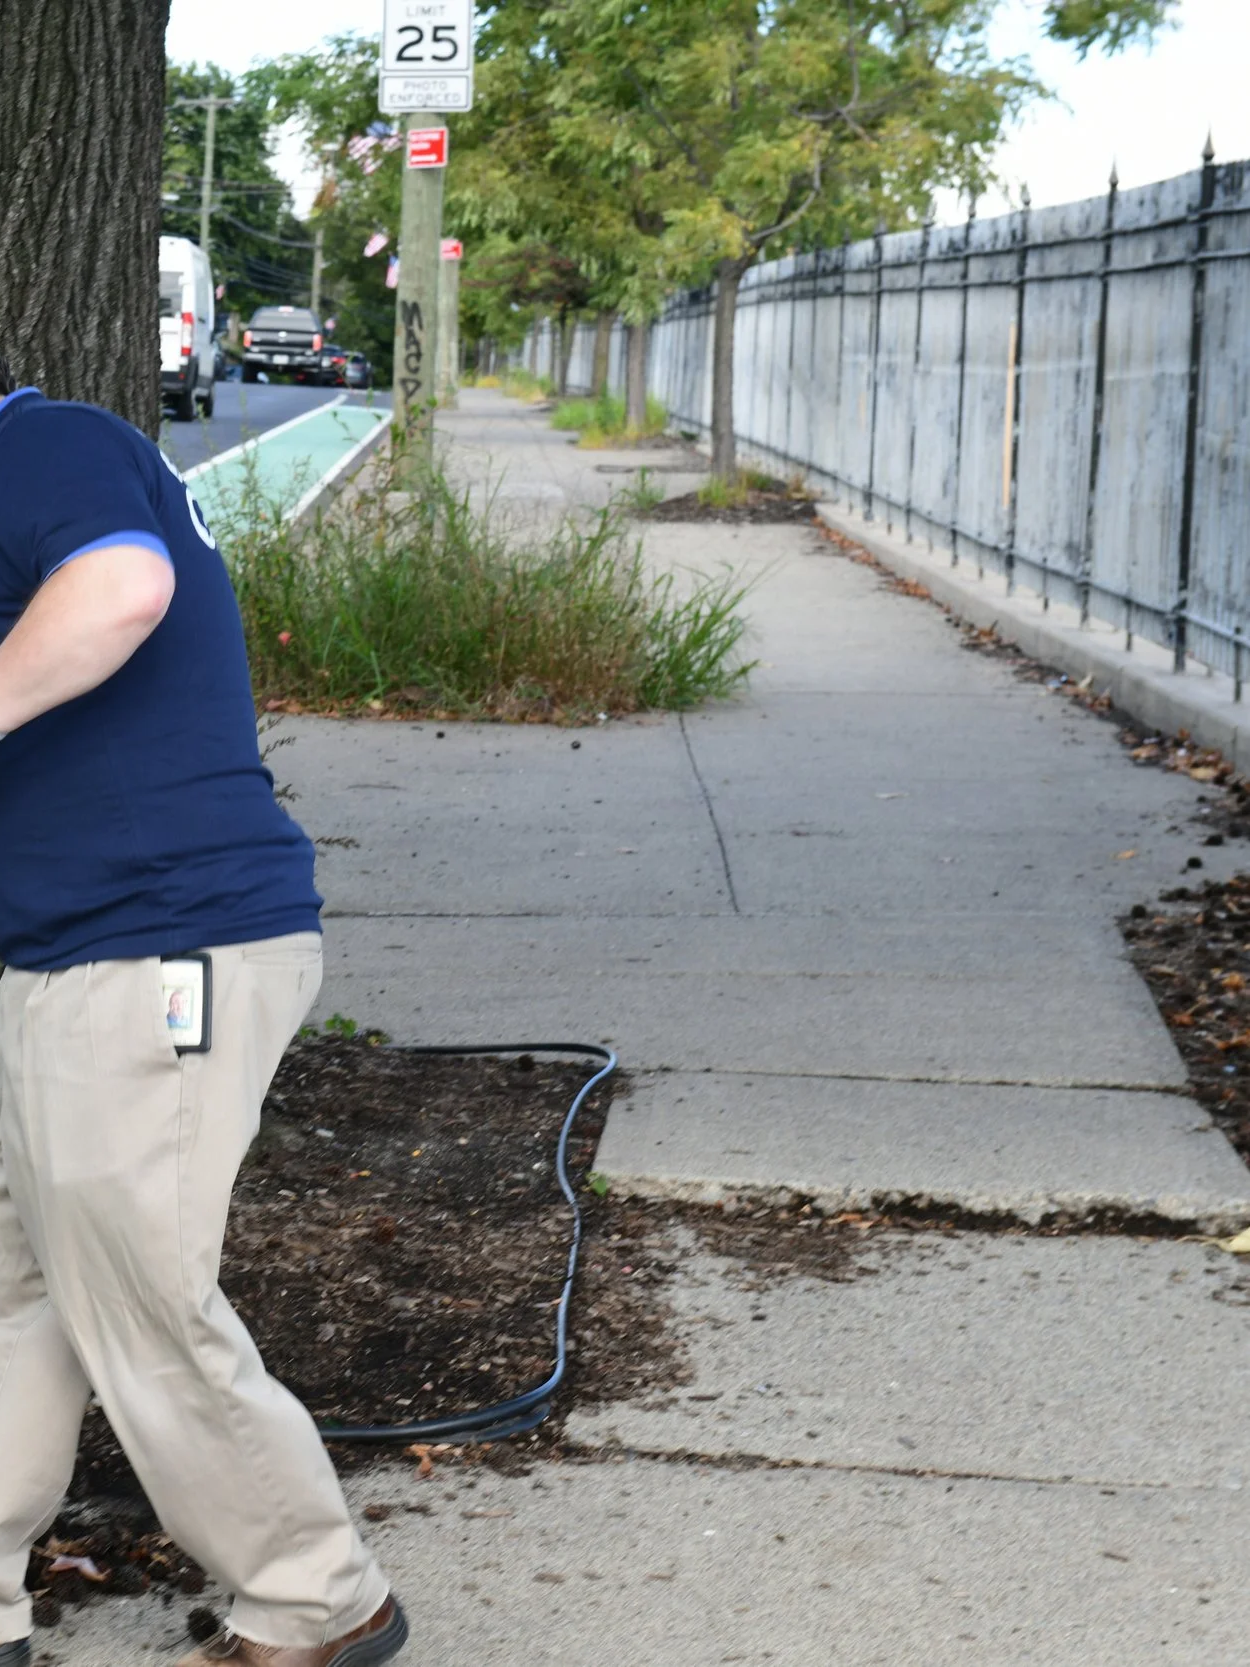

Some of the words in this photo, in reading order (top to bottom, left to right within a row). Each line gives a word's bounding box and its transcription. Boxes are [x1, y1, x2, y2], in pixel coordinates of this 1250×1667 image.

[405, 5, 446, 18] LIMIT
[395, 25, 459, 62] 25
[403, 80, 448, 91] PHOTO
[389, 92, 461, 104] ENFORCED
